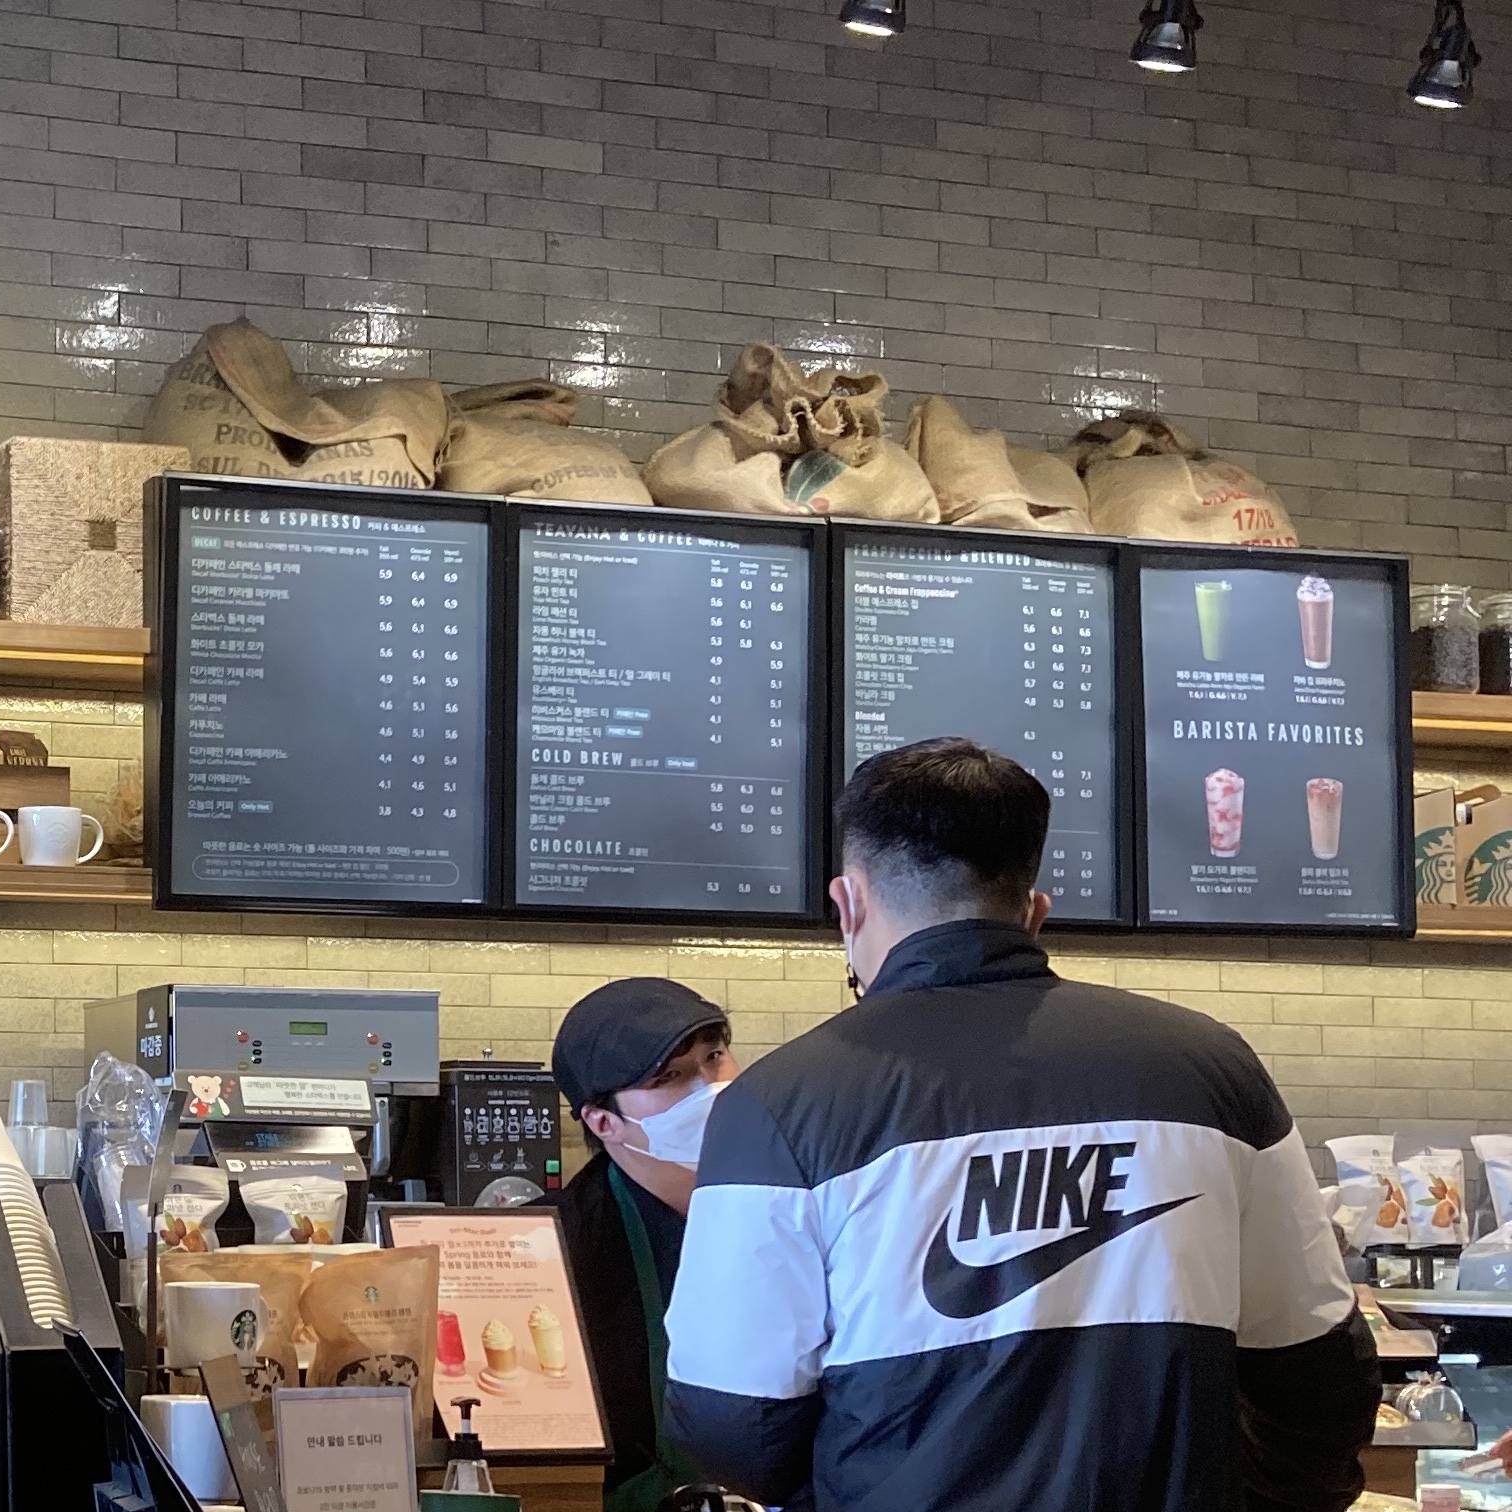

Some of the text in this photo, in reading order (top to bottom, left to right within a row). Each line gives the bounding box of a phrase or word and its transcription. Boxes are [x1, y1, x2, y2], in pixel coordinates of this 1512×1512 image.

[191, 506, 361, 530] COFFEE & ESPRESSO
[1233, 508, 1275, 531] 17/18
[1173, 720, 1364, 746] BARISTA FAVORITES
[531, 748, 623, 766] COLD BREW
[529, 838, 622, 855] CHOCOLATE
[140, 1035, 162, 1059] 마감중
[956, 1141, 1137, 1243] NIKE
[307, 1433, 382, 1448] 안내 말씀 드립니다
